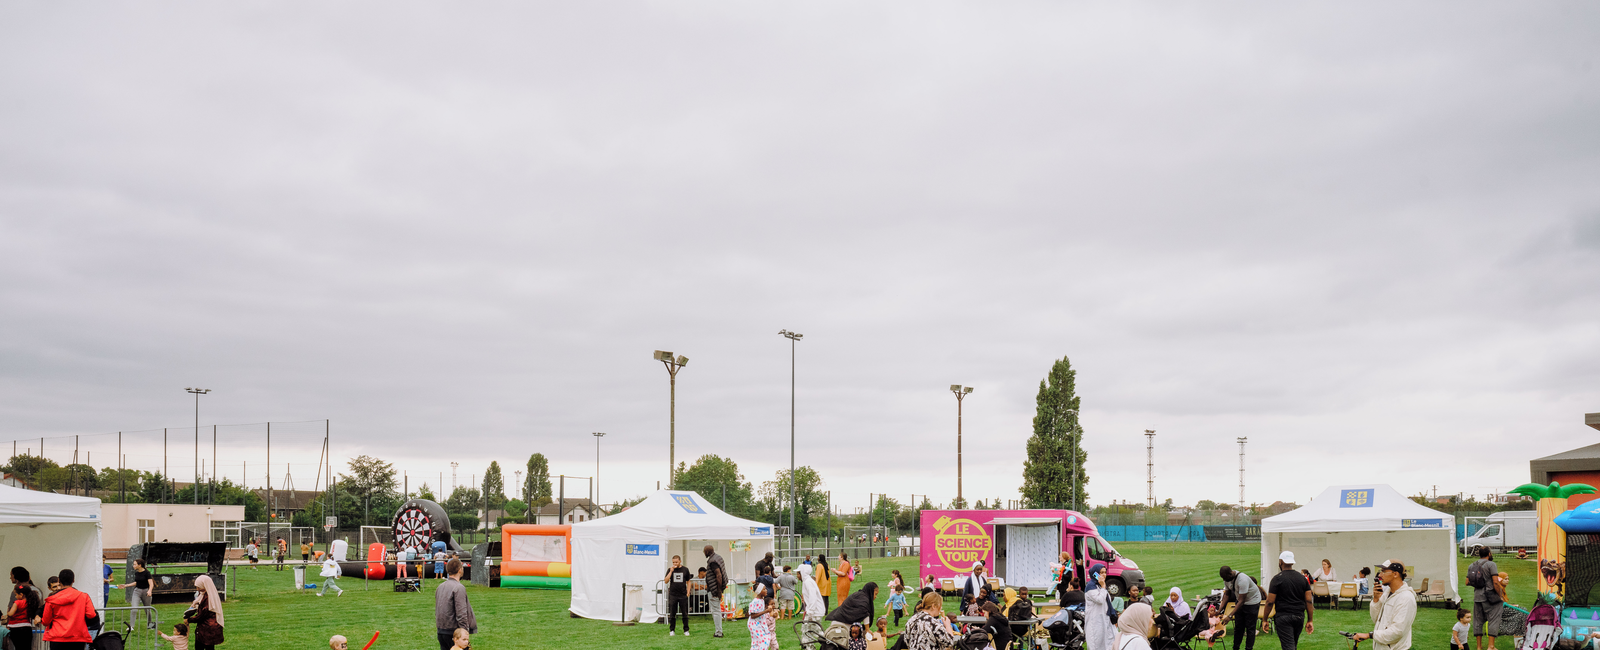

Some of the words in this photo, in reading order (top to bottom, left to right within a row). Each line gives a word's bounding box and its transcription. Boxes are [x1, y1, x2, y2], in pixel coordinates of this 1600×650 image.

[956, 524, 969, 534] LE
[1245, 527, 1261, 535] GARA
[937, 538, 988, 548] SCIENCE
[945, 552, 978, 561] TOUR
